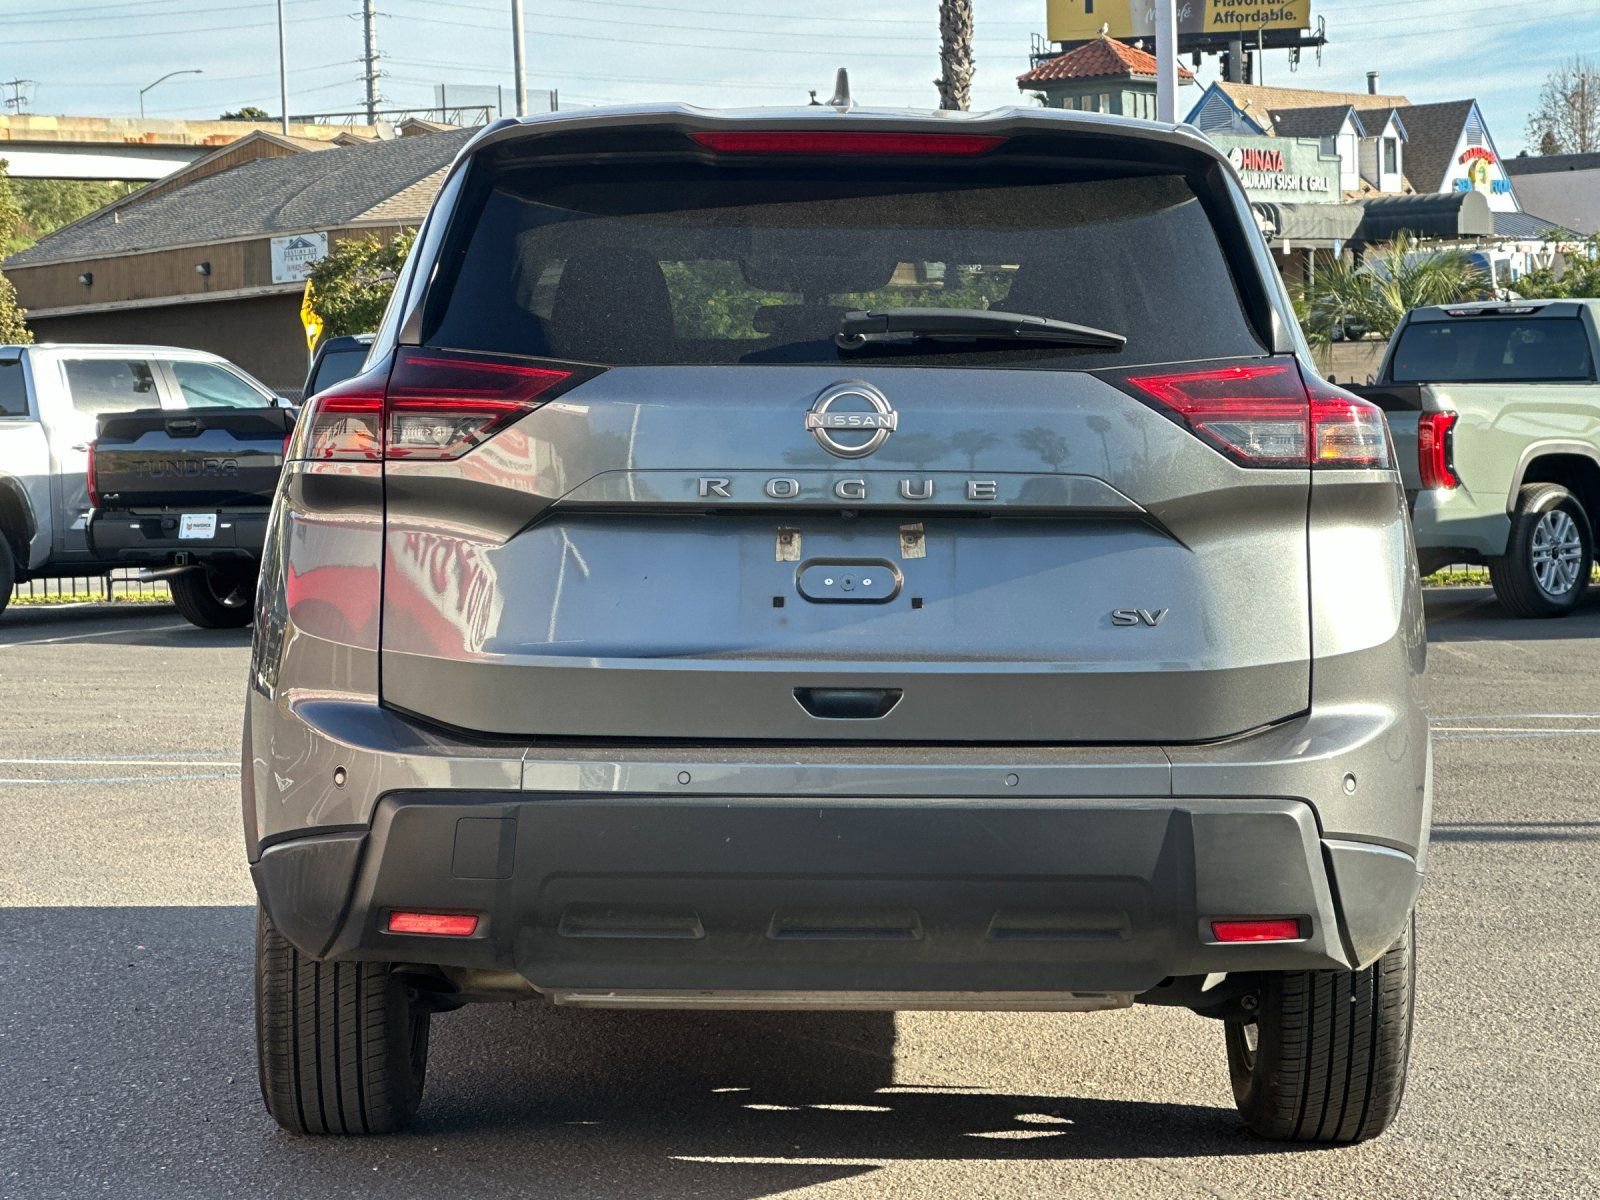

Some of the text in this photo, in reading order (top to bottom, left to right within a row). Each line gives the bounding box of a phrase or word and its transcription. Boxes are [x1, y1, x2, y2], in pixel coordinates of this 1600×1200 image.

[1213, 8, 1297, 24] Affordable.
[1243, 147, 1285, 171] HINATA
[1277, 174, 1300, 190] SUSHI
[1301, 176, 1308, 191] &
[1309, 176, 1330, 192] GRILL
[811, 415, 890, 427] NISSAN
[132, 458, 239, 478] TUNDRA
[699, 477, 997, 499] ROGUE
[1112, 609, 1168, 626] SV
